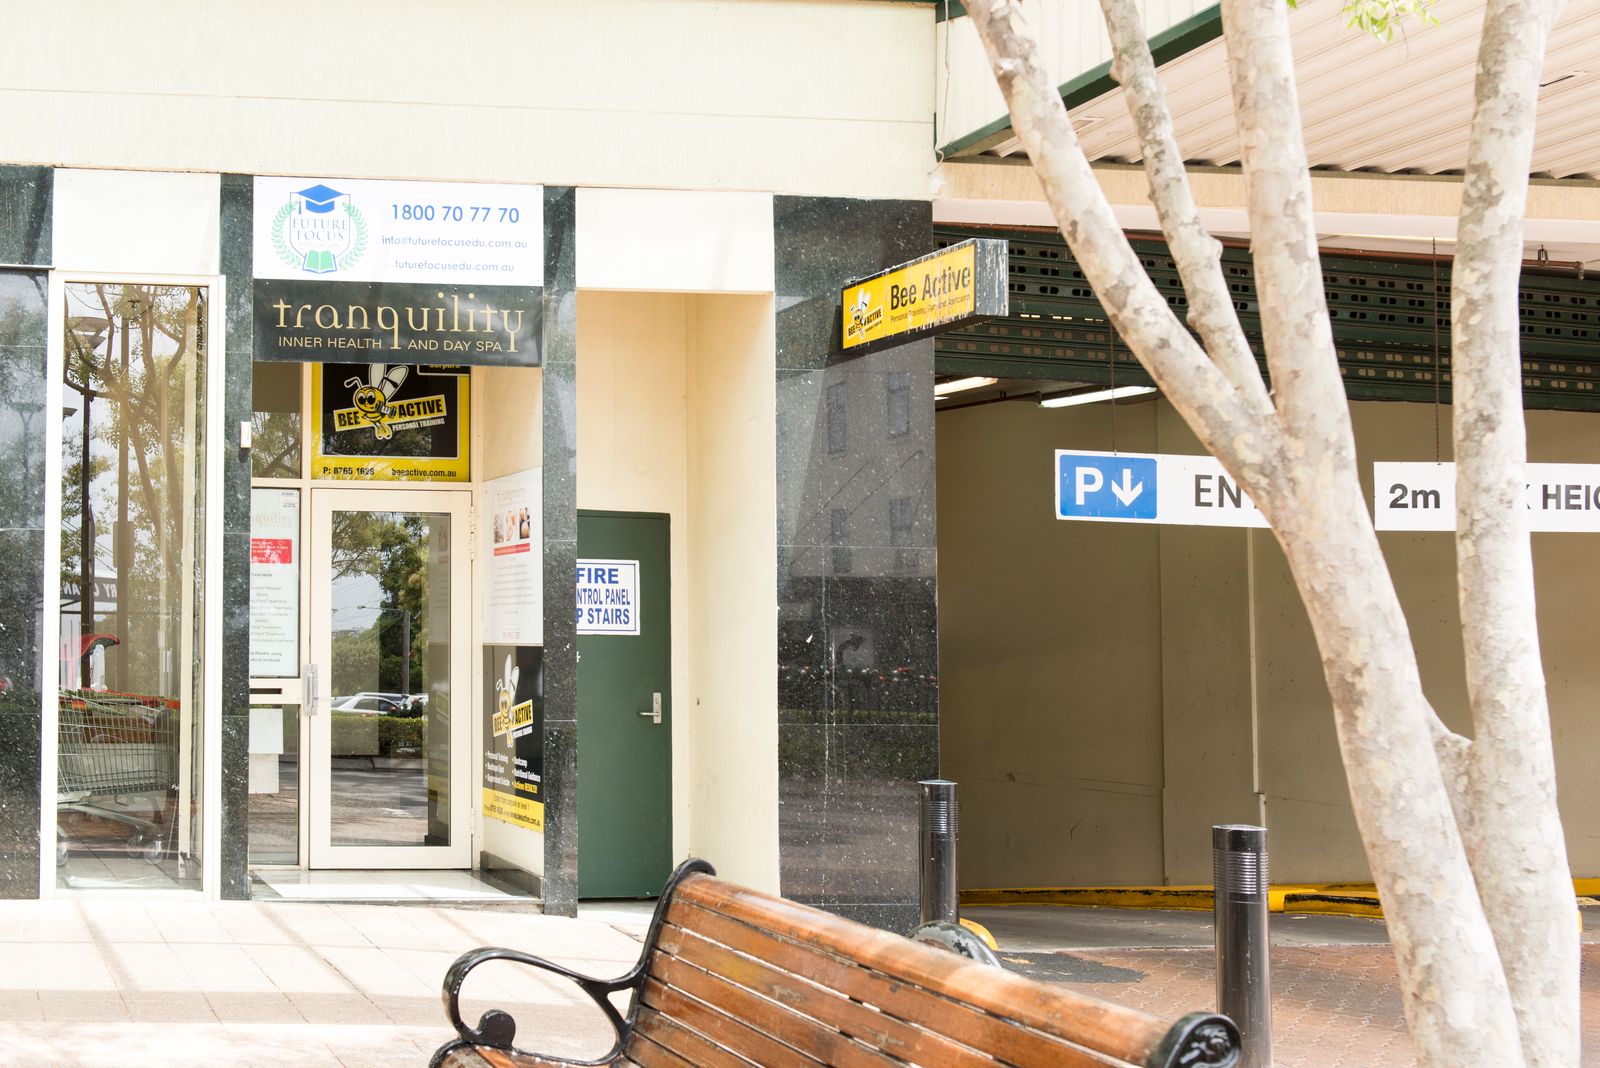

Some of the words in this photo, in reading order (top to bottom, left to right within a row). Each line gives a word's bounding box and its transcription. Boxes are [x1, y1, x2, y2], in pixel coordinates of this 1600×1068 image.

[392, 204, 435, 221] 1800
[442, 206, 463, 222] 70
[470, 207, 490, 223] 77
[498, 208, 519, 223] 70
[293, 218, 348, 231] FUTURE
[297, 230, 344, 242] FOCUS
[382, 235, 528, 249] info@futurefocusedu.com.au
[395, 259, 515, 272] futurefocusedu.com.au
[891, 284, 917, 310] Bee
[922, 266, 971, 301] Active
[272, 292, 525, 353] tranquility
[848, 323, 856, 336] BEE
[866, 309, 882, 326] ACTIVE
[278, 336, 322, 348] INNER
[327, 337, 382, 349] HEALTH
[408, 339, 439, 351] AND
[443, 340, 472, 352] DAY
[476, 341, 503, 352] SPA
[338, 411, 361, 427] BEE
[398, 398, 443, 418] ACTIVE
[392, 423, 419, 432] PERSONAL
[420, 418, 445, 428] TRAINING
[323, 467, 331, 475] P:
[333, 467, 353, 476] 8765
[391, 468, 457, 478] beeactive.com.au
[1074, 467, 1104, 506] P
[1195, 474, 1259, 509] EN
[1389, 483, 1441, 510] 2m
[1542, 484, 1600, 510] HEI
[576, 567, 619, 584] FIRE
[605, 589, 631, 605] PANEL
[587, 608, 630, 625] STAIRS
[494, 716, 502, 733] BEE
[514, 705, 532, 725] ACTIVE
